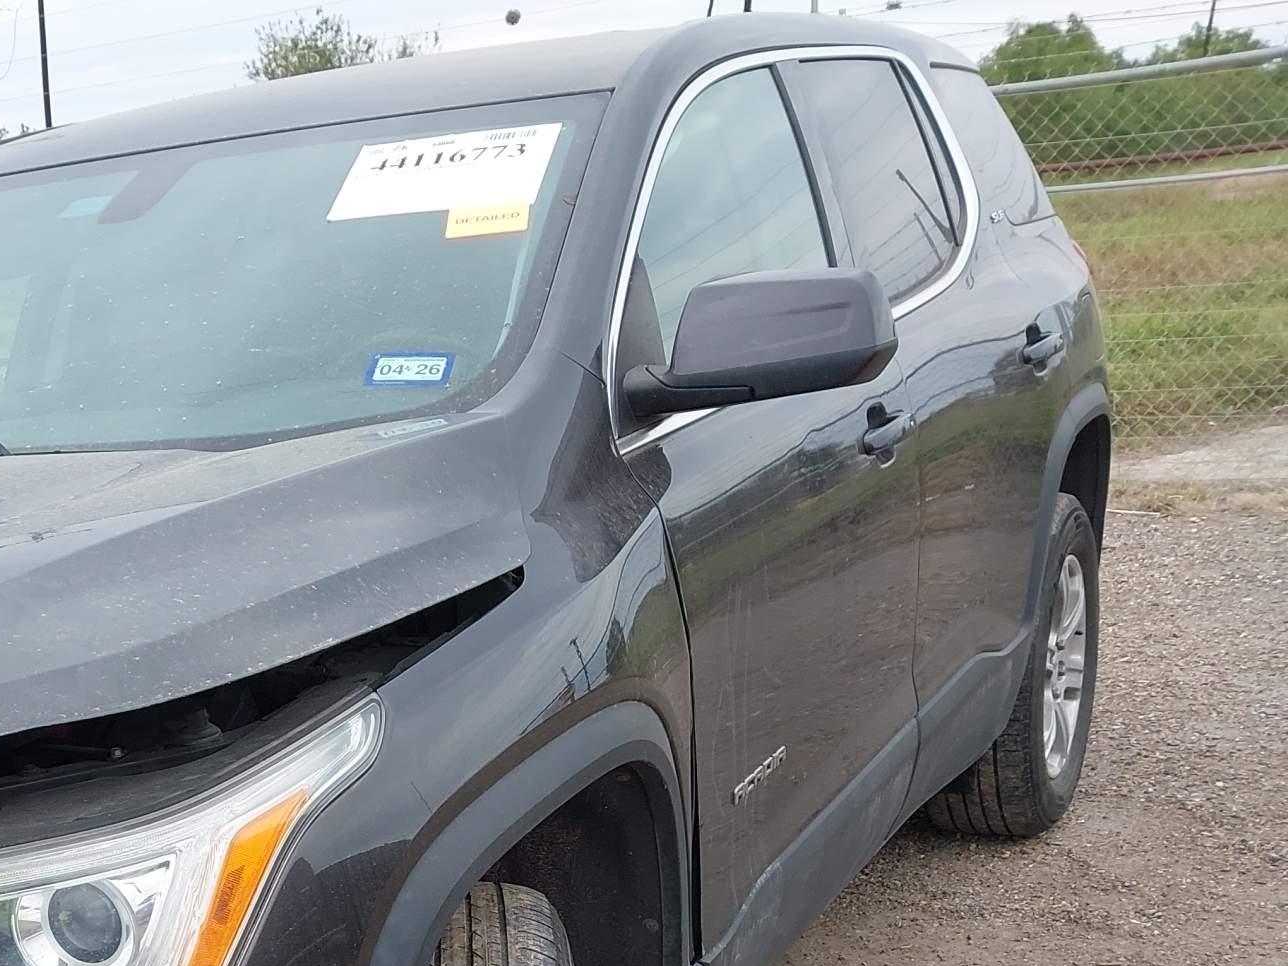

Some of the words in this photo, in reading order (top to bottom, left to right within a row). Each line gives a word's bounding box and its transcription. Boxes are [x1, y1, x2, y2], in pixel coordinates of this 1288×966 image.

[370, 143, 527, 171] 44116773
[455, 211, 521, 225] DETAILED
[379, 363, 404, 376] 04
[414, 363, 442, 376] 26
